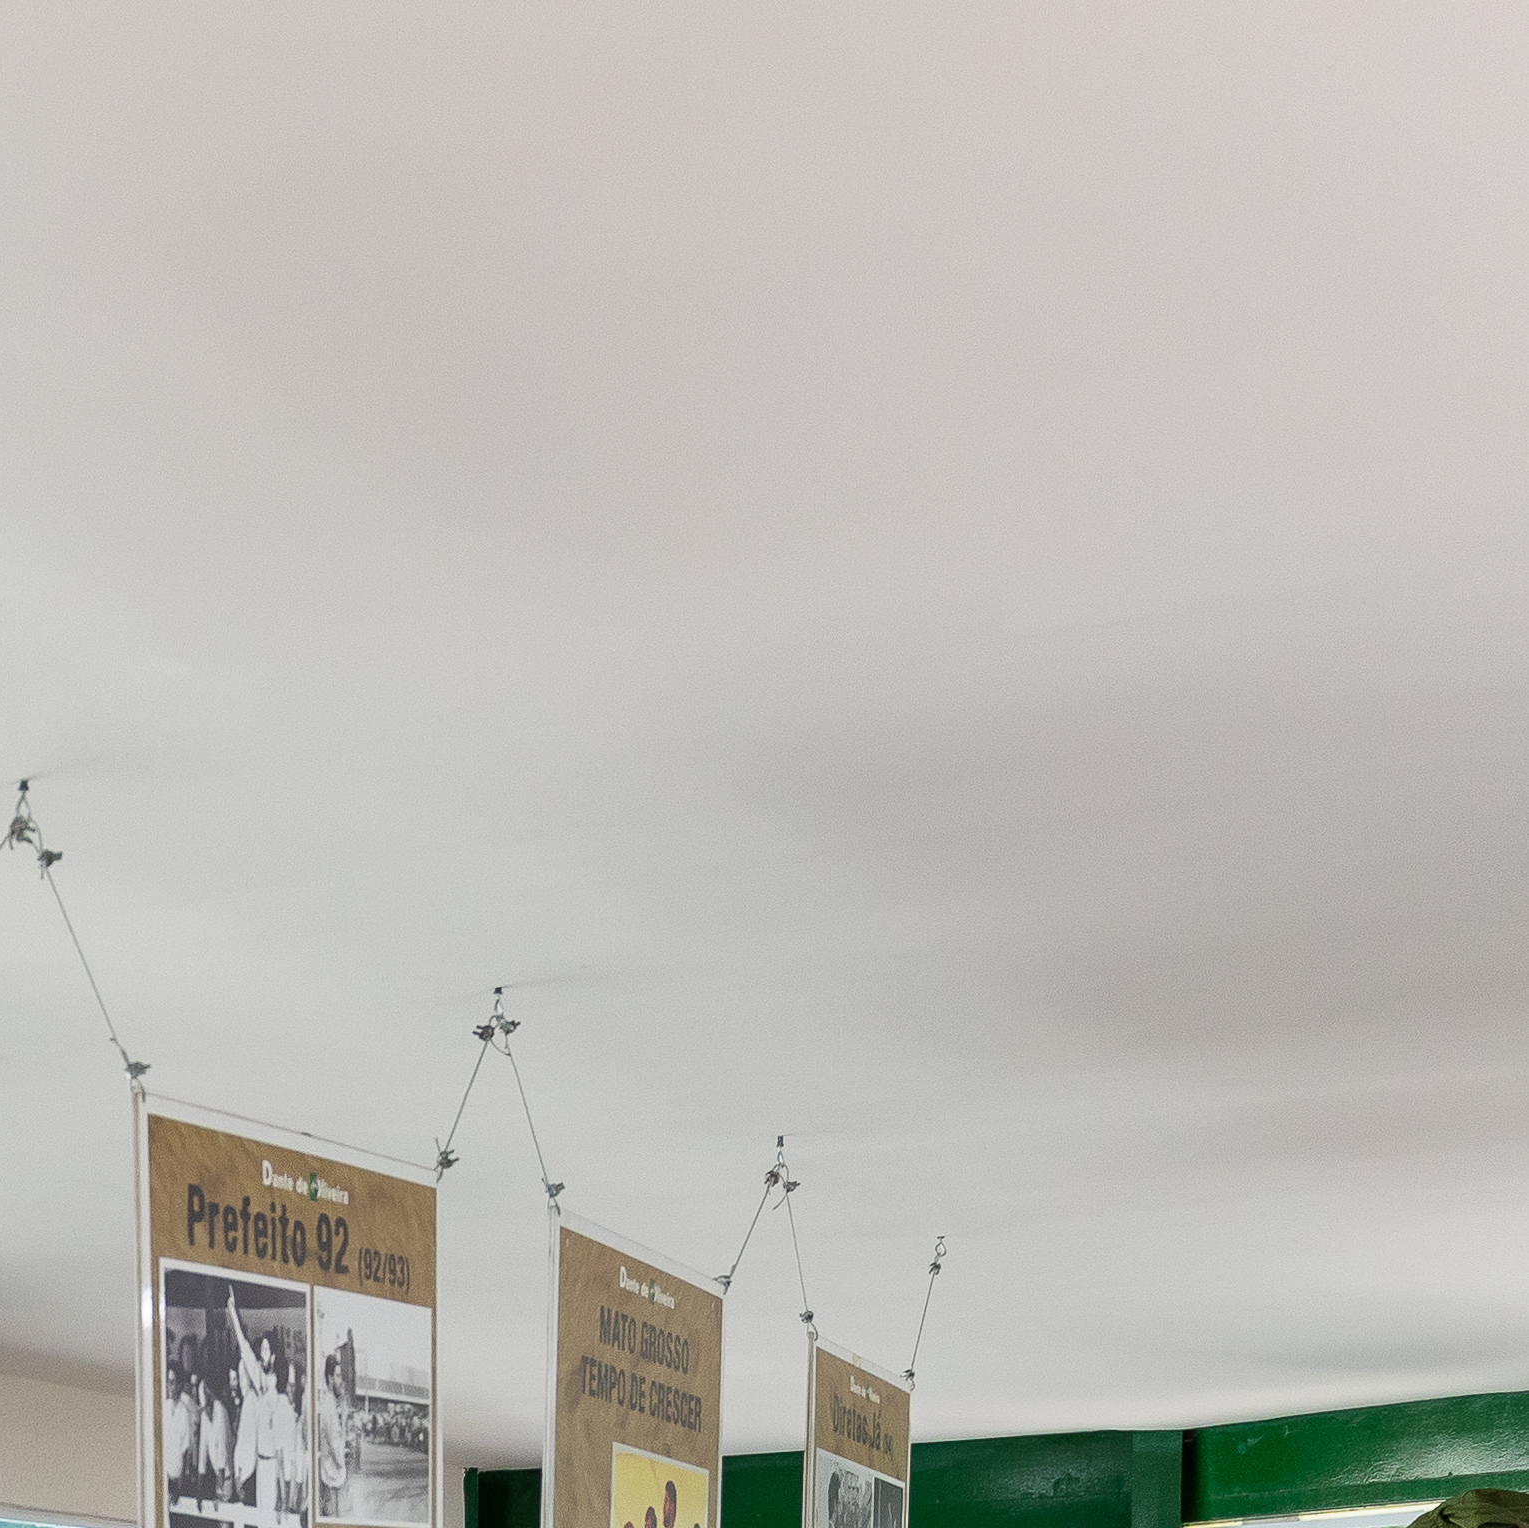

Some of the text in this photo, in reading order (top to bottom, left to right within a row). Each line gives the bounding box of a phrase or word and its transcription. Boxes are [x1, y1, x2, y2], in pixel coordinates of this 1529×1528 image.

[186, 1183, 411, 1294] Prefeito 92 (92/93)
[599, 1305, 690, 1375] MATO GROSSO
[580, 1355, 702, 1433] TEMPO DE CRESCER
